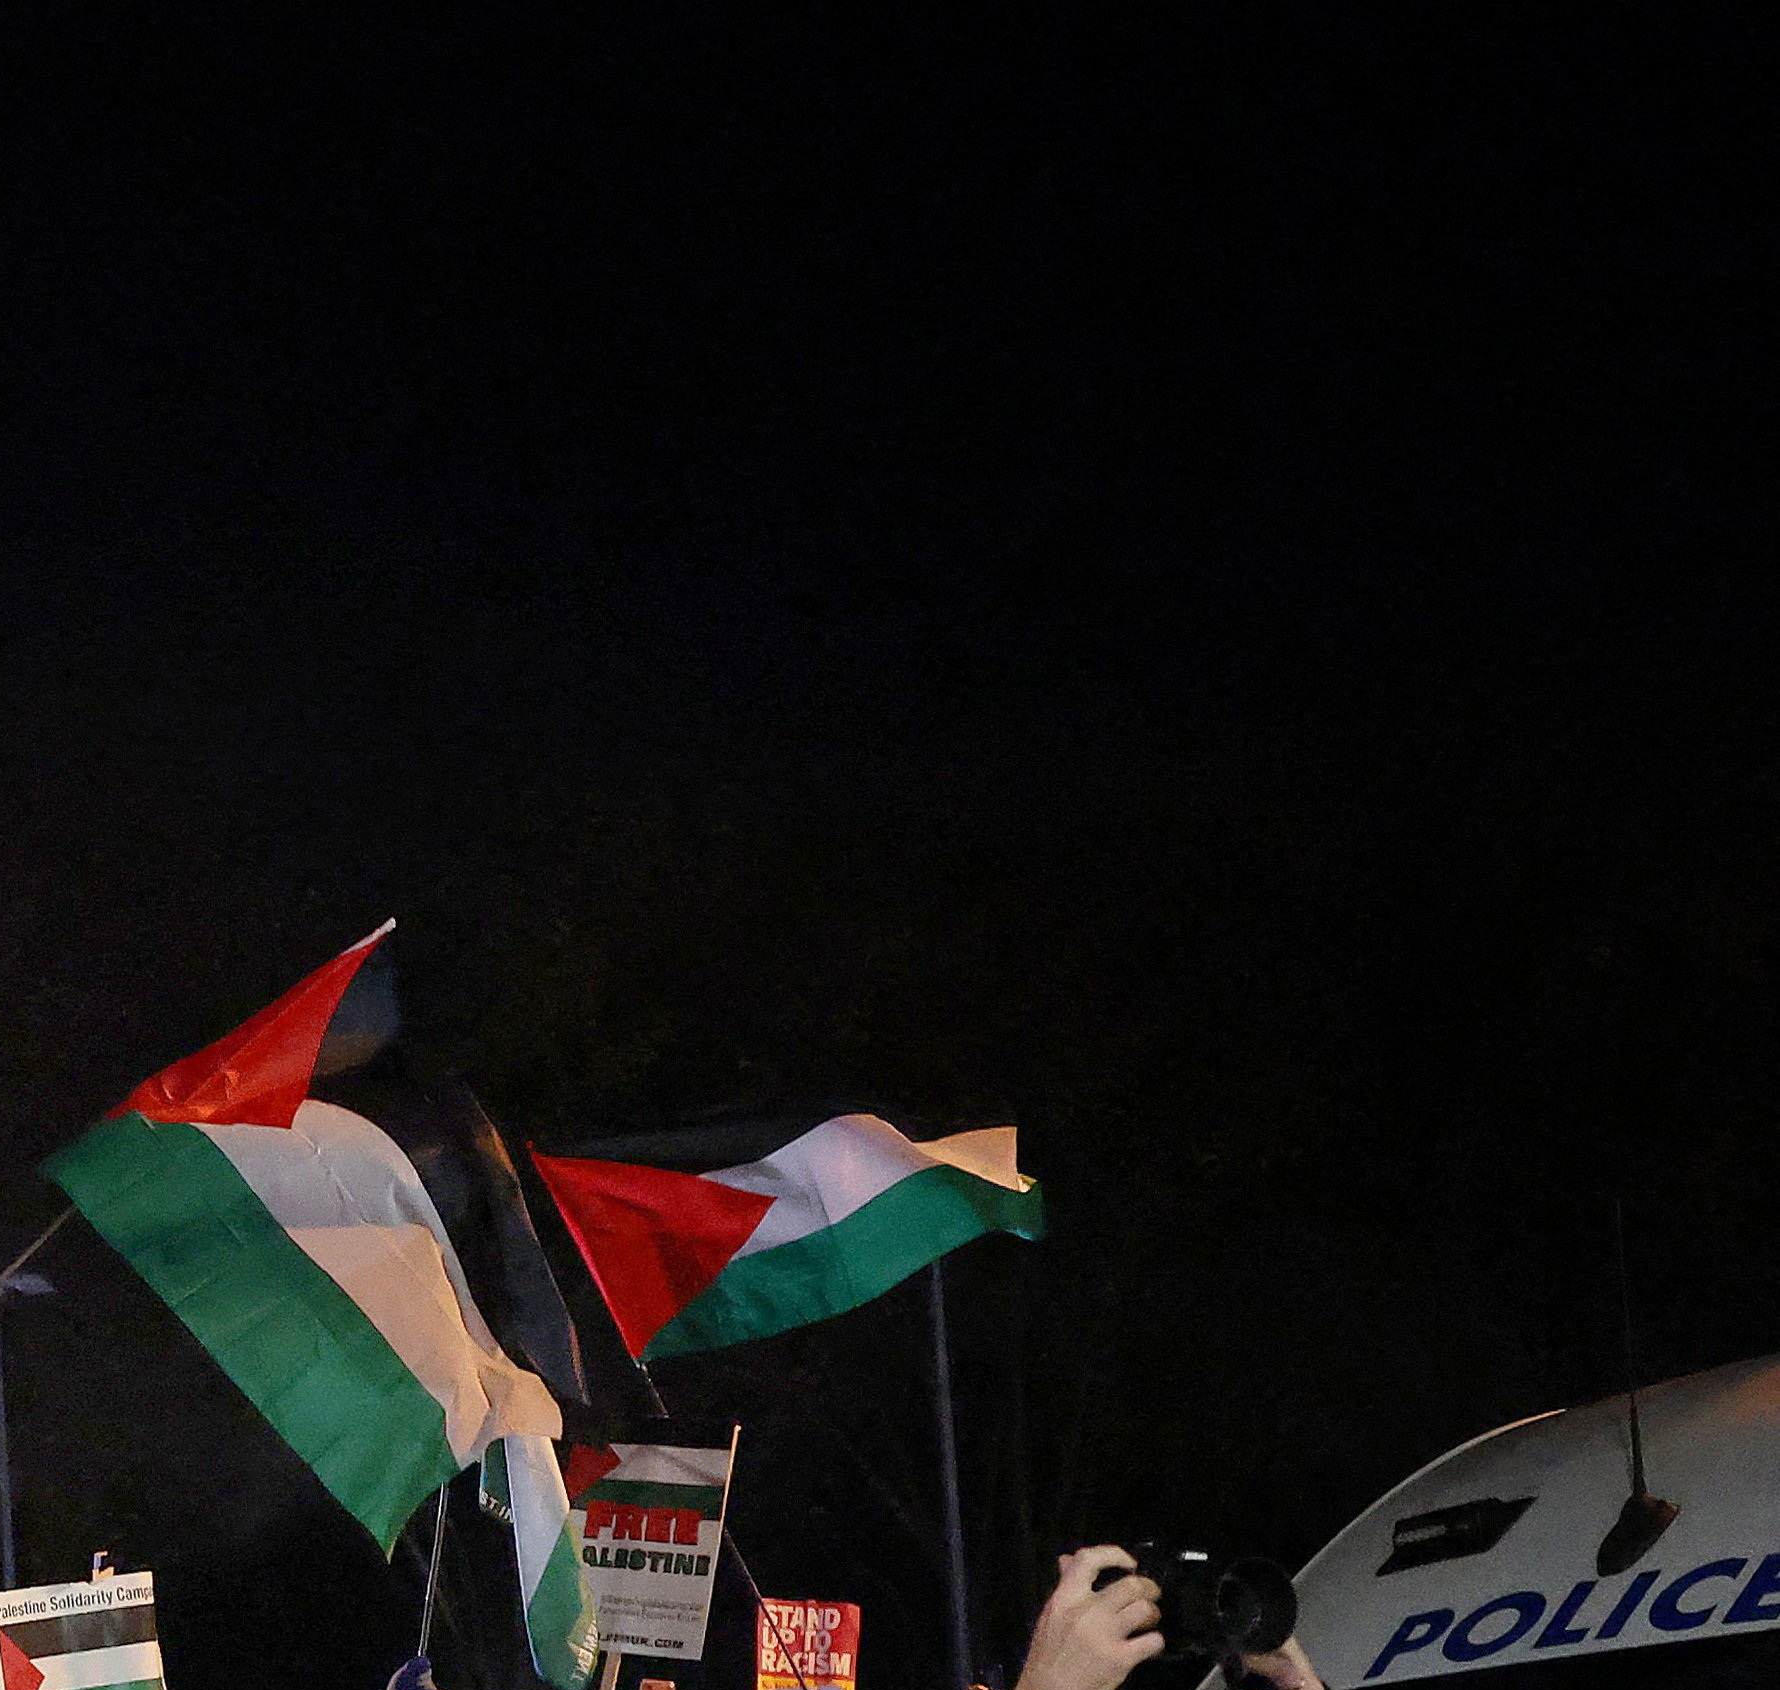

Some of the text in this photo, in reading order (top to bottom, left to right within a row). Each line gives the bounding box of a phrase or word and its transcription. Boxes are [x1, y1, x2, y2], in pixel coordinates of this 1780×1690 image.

[582, 1499, 704, 1546] FREE
[49, 1589, 113, 1613] Solidarity
[762, 1604, 841, 1631] STAND
[1363, 1552, 1780, 1680] POLICE
[762, 1626, 832, 1651] UP TO
[761, 1647, 852, 1676] RACISM
